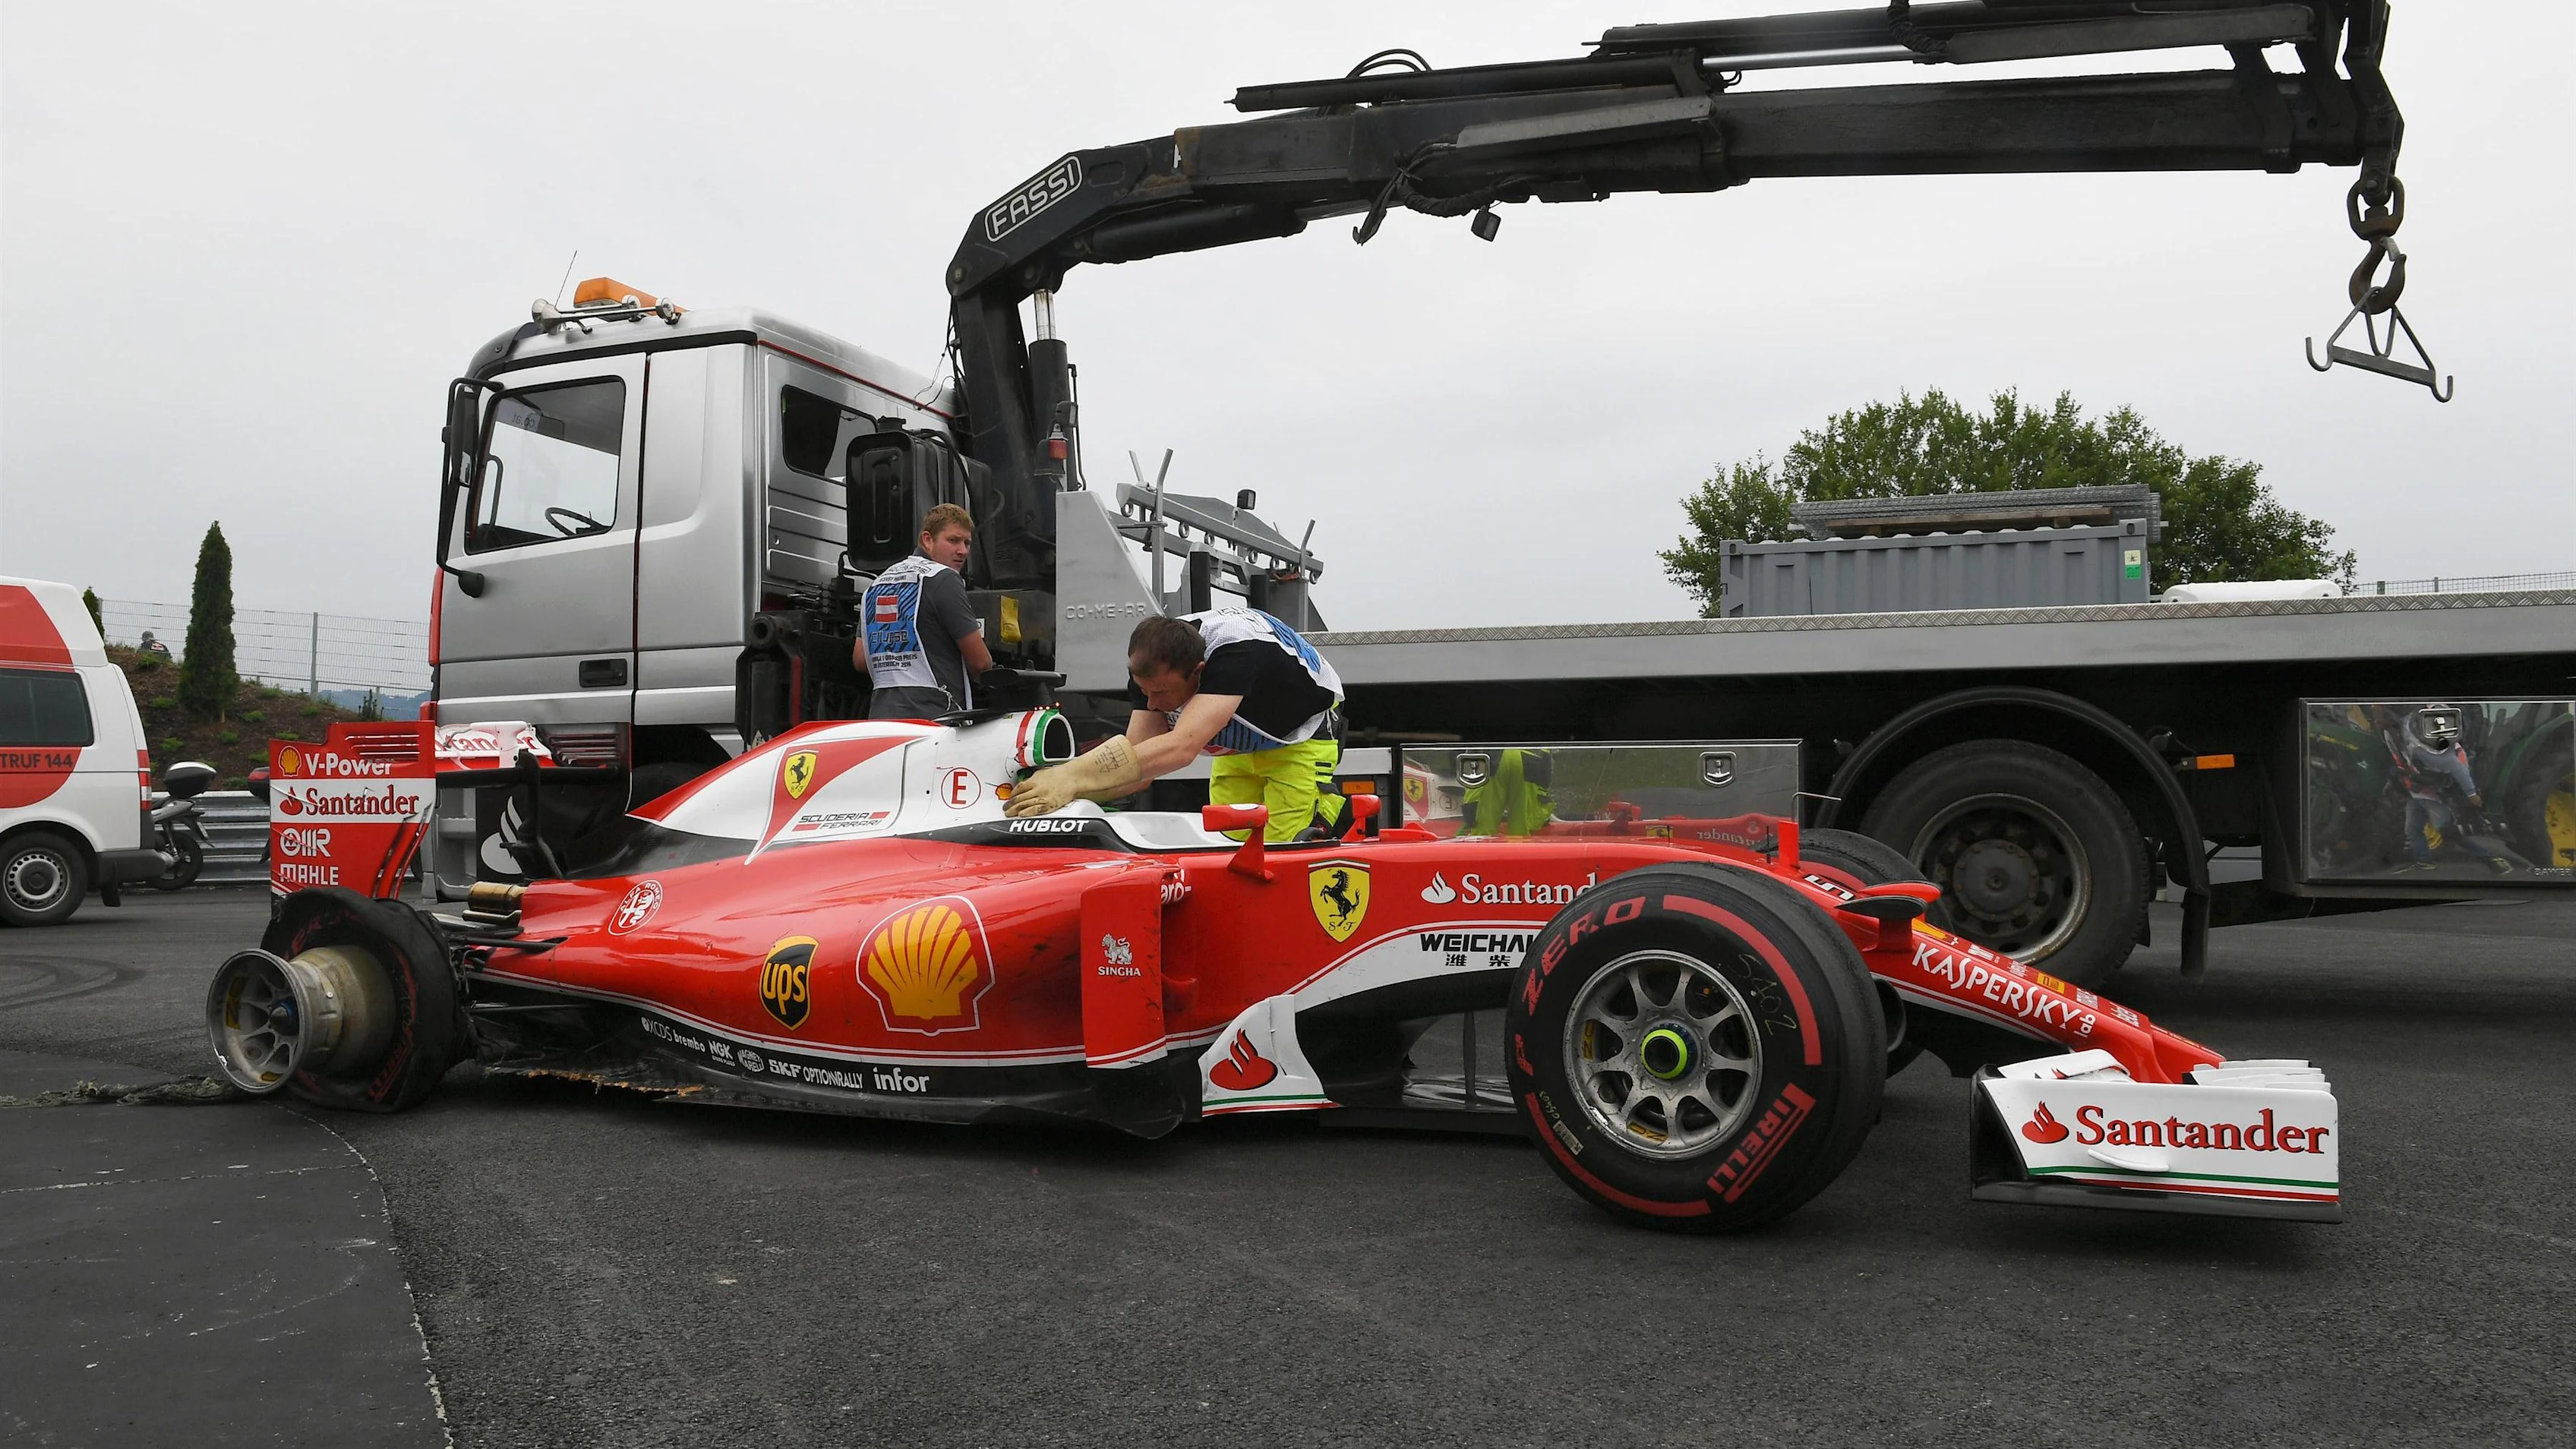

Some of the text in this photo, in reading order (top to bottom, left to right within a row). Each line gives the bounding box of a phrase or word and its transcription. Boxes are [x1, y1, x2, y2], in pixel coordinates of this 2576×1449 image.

[990, 163, 1075, 235] FASSI
[1065, 602, 1147, 620] CO-ME-AR
[46, 753, 73, 768] 144
[305, 752, 393, 776] V-Power
[305, 784, 419, 816] Santander
[952, 772, 968, 805] E
[800, 812, 870, 823] SCUDERIA
[819, 819, 882, 830] FERRARI
[1009, 819, 1090, 833] HUBLOT
[280, 863, 339, 886] MAHLE
[1460, 872, 1597, 904] Santand
[620, 882, 661, 912] ALFA ROMEO
[1420, 934, 1533, 952] WEICHAI
[1521, 895, 1646, 1016] ZERO
[1097, 966, 1141, 977] SINGHA
[1911, 942, 2082, 1029] KASPERSKY
[762, 961, 807, 1016] ups
[2073, 1013, 2097, 1038] lab
[673, 1029, 706, 1053] brembo
[708, 1039, 734, 1060] NGK
[768, 1059, 802, 1078] SKF
[873, 1065, 930, 1092] infor
[1706, 1082, 1817, 1204] PIRELLI
[2076, 1104, 2330, 1155] Santander
